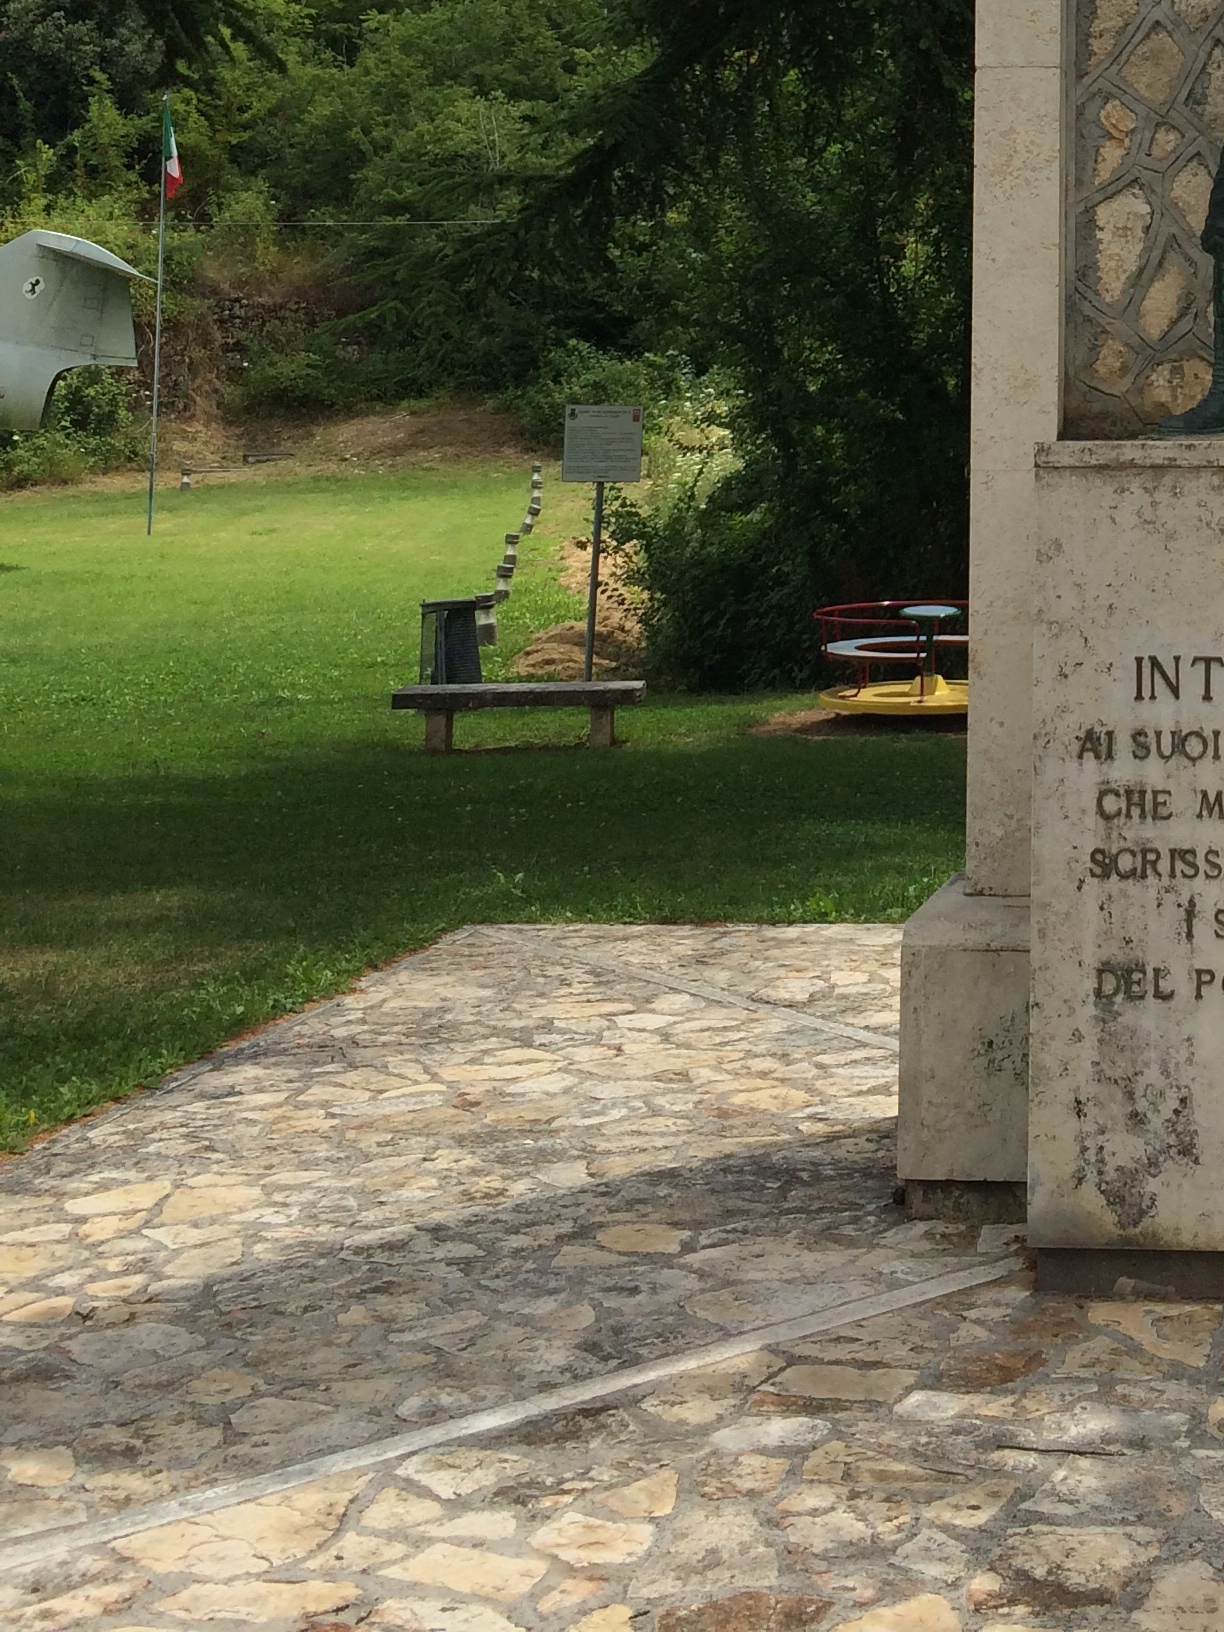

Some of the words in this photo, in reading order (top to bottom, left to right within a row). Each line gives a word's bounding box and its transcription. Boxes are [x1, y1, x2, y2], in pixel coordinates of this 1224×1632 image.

[1077, 729, 1115, 761] AI
[1132, 729, 1221, 762] SUOI
[1097, 789, 1173, 820] CHE
[1184, 908, 1195, 942] I
[1094, 968, 1175, 1001] DEL
